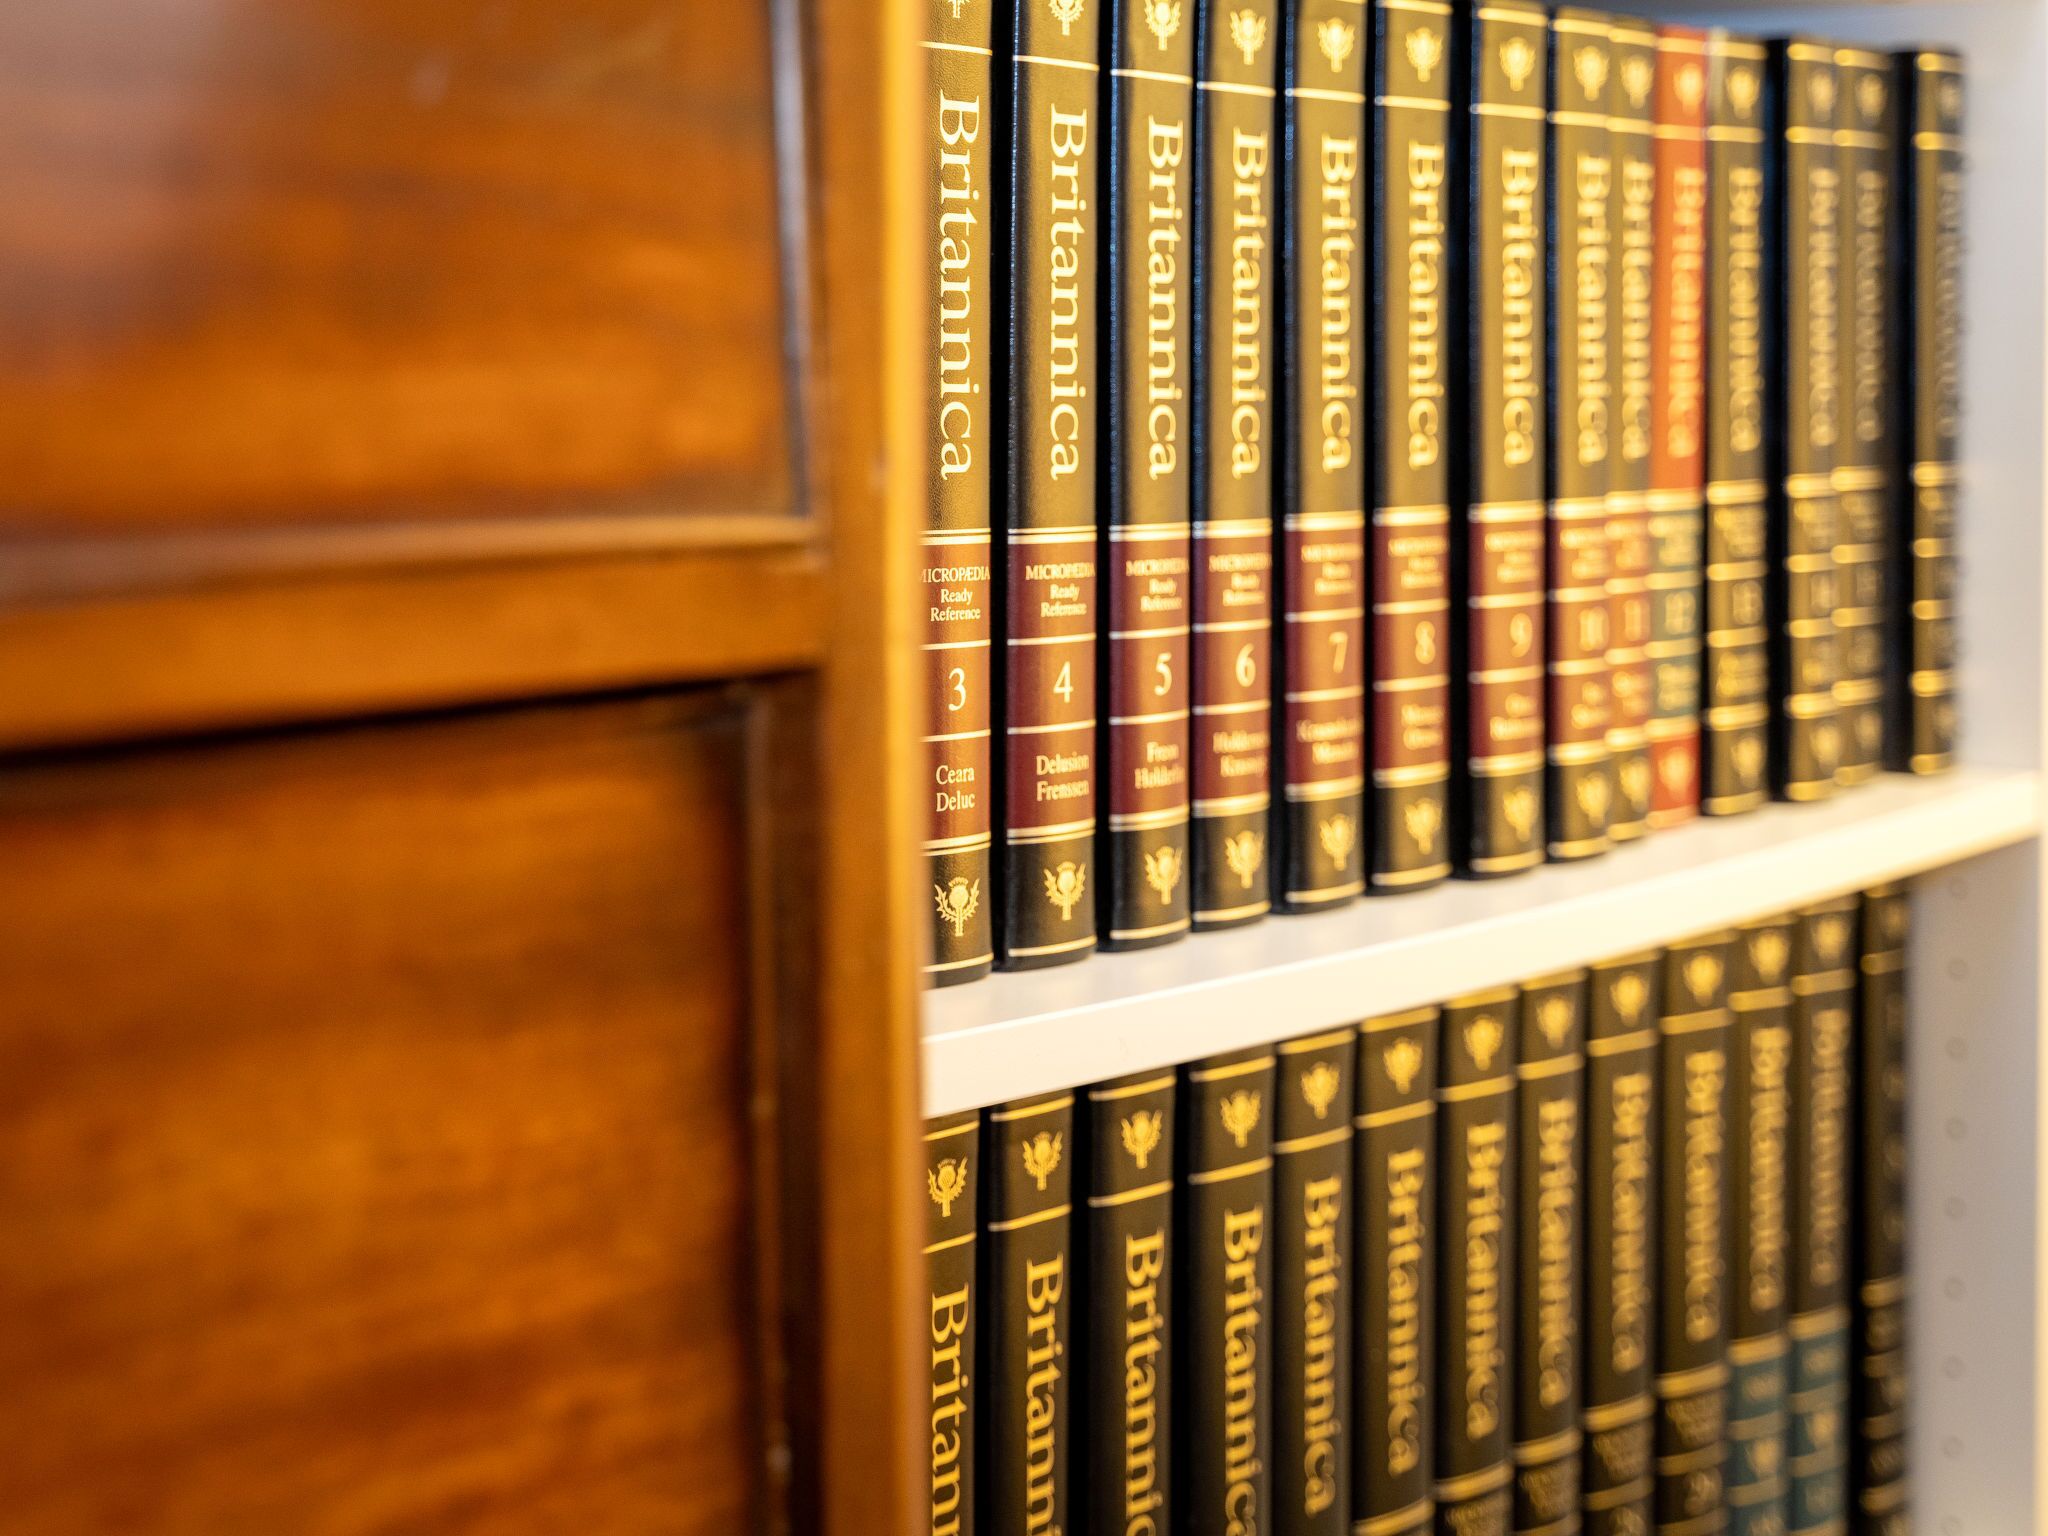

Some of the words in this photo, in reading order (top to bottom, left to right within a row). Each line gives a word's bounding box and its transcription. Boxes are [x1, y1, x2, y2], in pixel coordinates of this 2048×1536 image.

[939, 89, 980, 481] Britannica
[1050, 103, 1087, 481] Britannica
[1148, 115, 1185, 481] Britannica
[1232, 126, 1268, 480] Britannica
[1321, 134, 1358, 474] Britannica
[1408, 140, 1445, 471] Britannica
[1502, 148, 1539, 467] Britannica
[1577, 153, 1611, 466] Britannica
[930, 607, 981, 622] Reference
[941, 588, 972, 605] Ready
[1328, 631, 1348, 673] 7
[1415, 620, 1436, 664] 8
[1510, 613, 1532, 658] 9
[1053, 661, 1073, 703] 4
[1154, 652, 1172, 696] 5
[1235, 643, 1256, 687] 6
[948, 667, 967, 711] 3
[936, 765, 975, 785] Ceara
[1036, 752, 1089, 776] Delusion
[936, 791, 975, 812] Deluc
[1388, 1147, 1425, 1477] Britannica
[1304, 1175, 1342, 1519] Britannica
